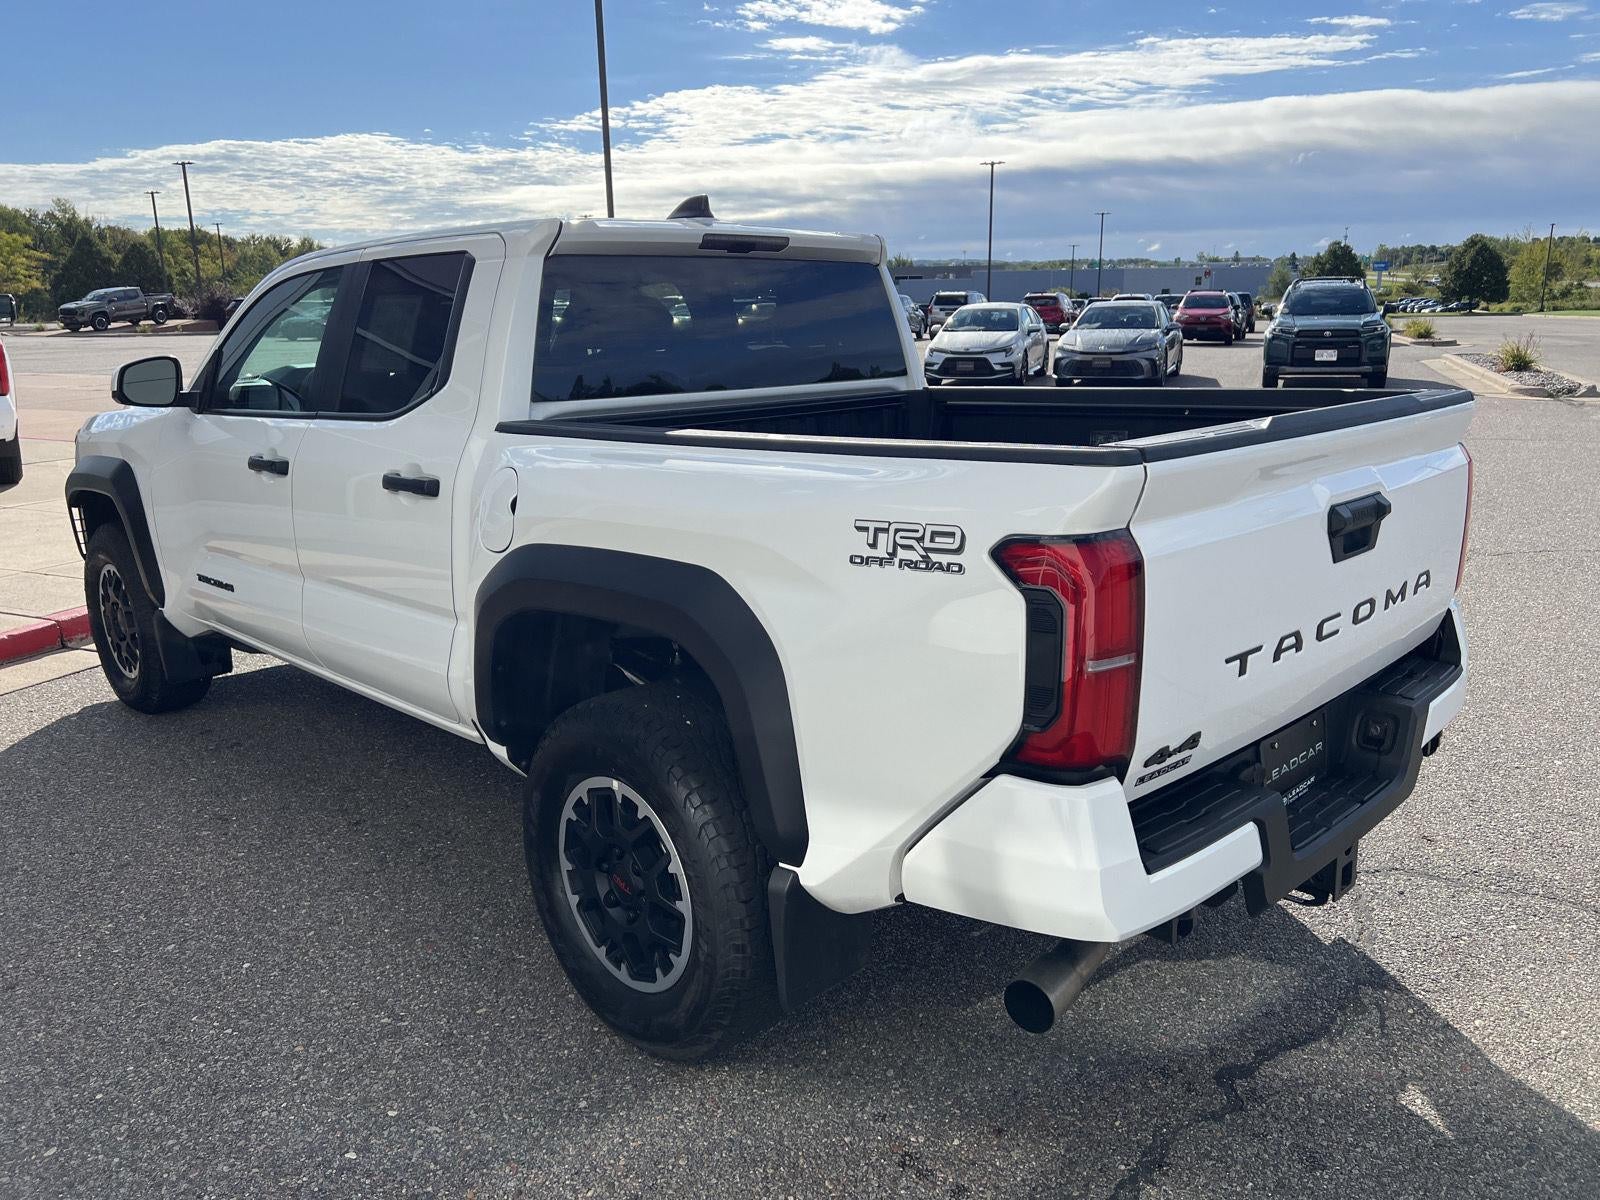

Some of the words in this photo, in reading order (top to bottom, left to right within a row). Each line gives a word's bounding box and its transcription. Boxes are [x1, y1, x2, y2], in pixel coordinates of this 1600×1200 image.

[854, 519, 966, 563] TRD
[849, 555, 895, 568] OFF
[898, 558, 965, 575] ROAD
[1224, 569, 1431, 677] TACOMA
[1134, 754, 1192, 787] LEADCAR
[1288, 776, 1315, 798] LEADCAR
